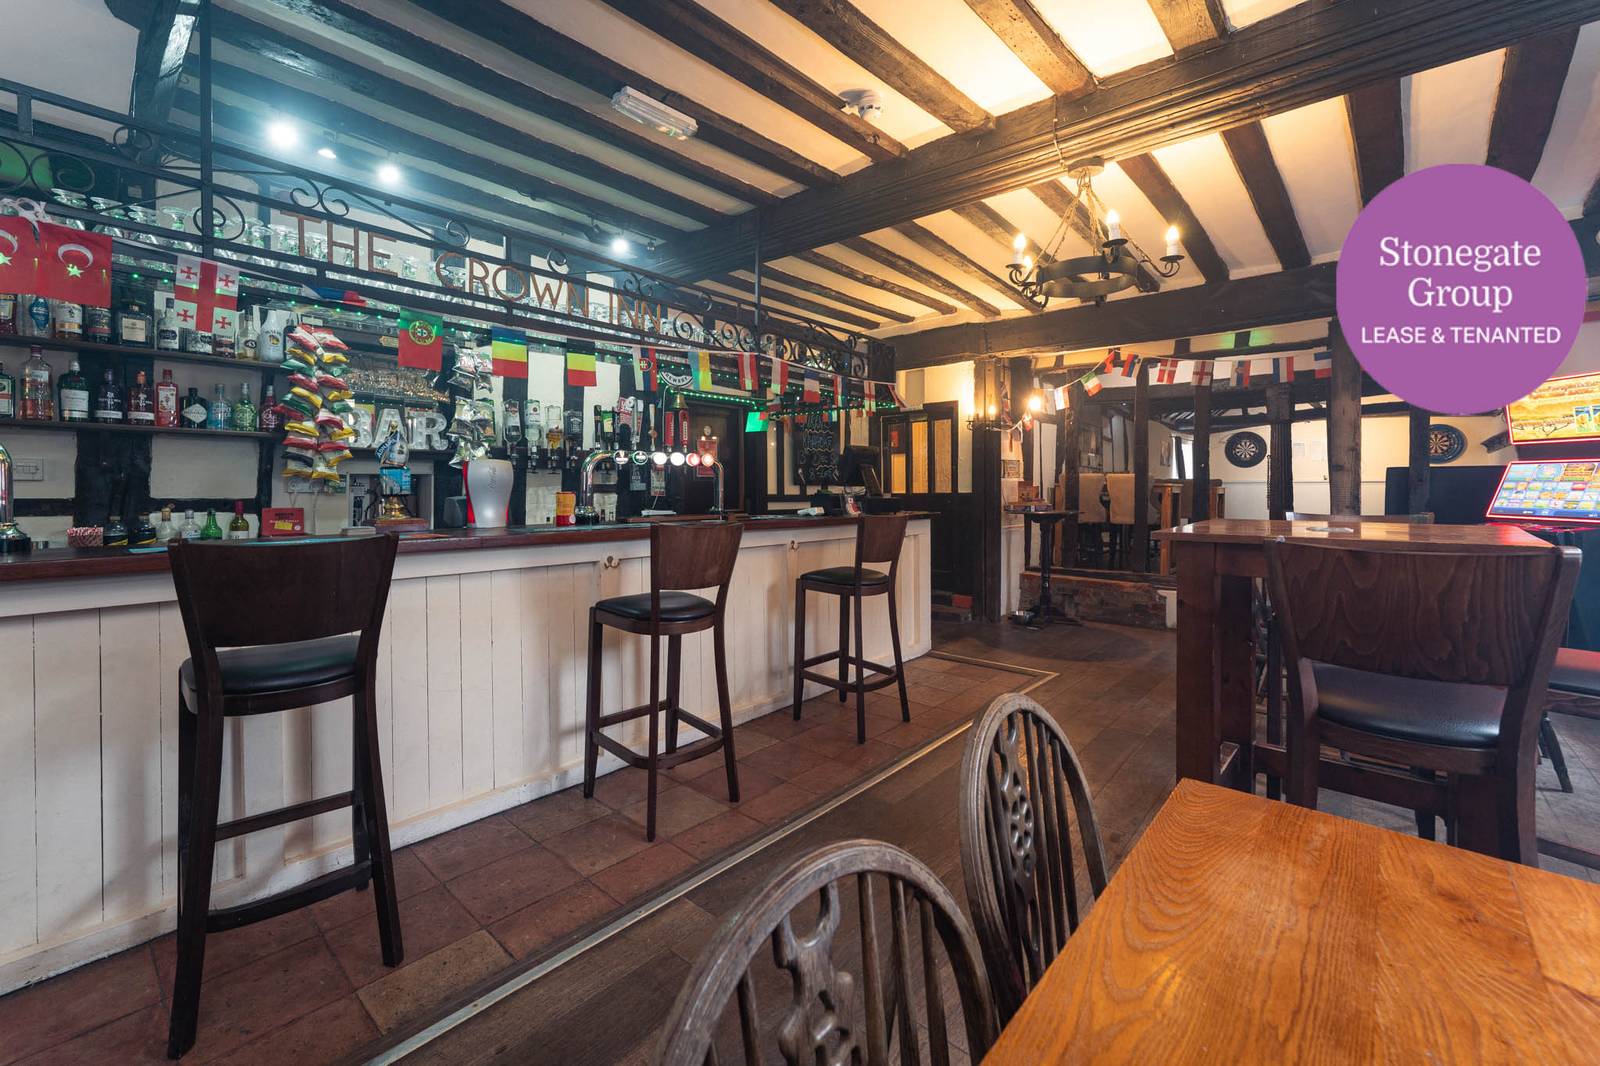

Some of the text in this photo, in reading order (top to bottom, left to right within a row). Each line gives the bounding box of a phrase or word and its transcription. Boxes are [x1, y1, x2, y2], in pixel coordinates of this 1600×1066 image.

[280, 210, 661, 334] THE CROWN INN
[341, 408, 449, 451] BAR
